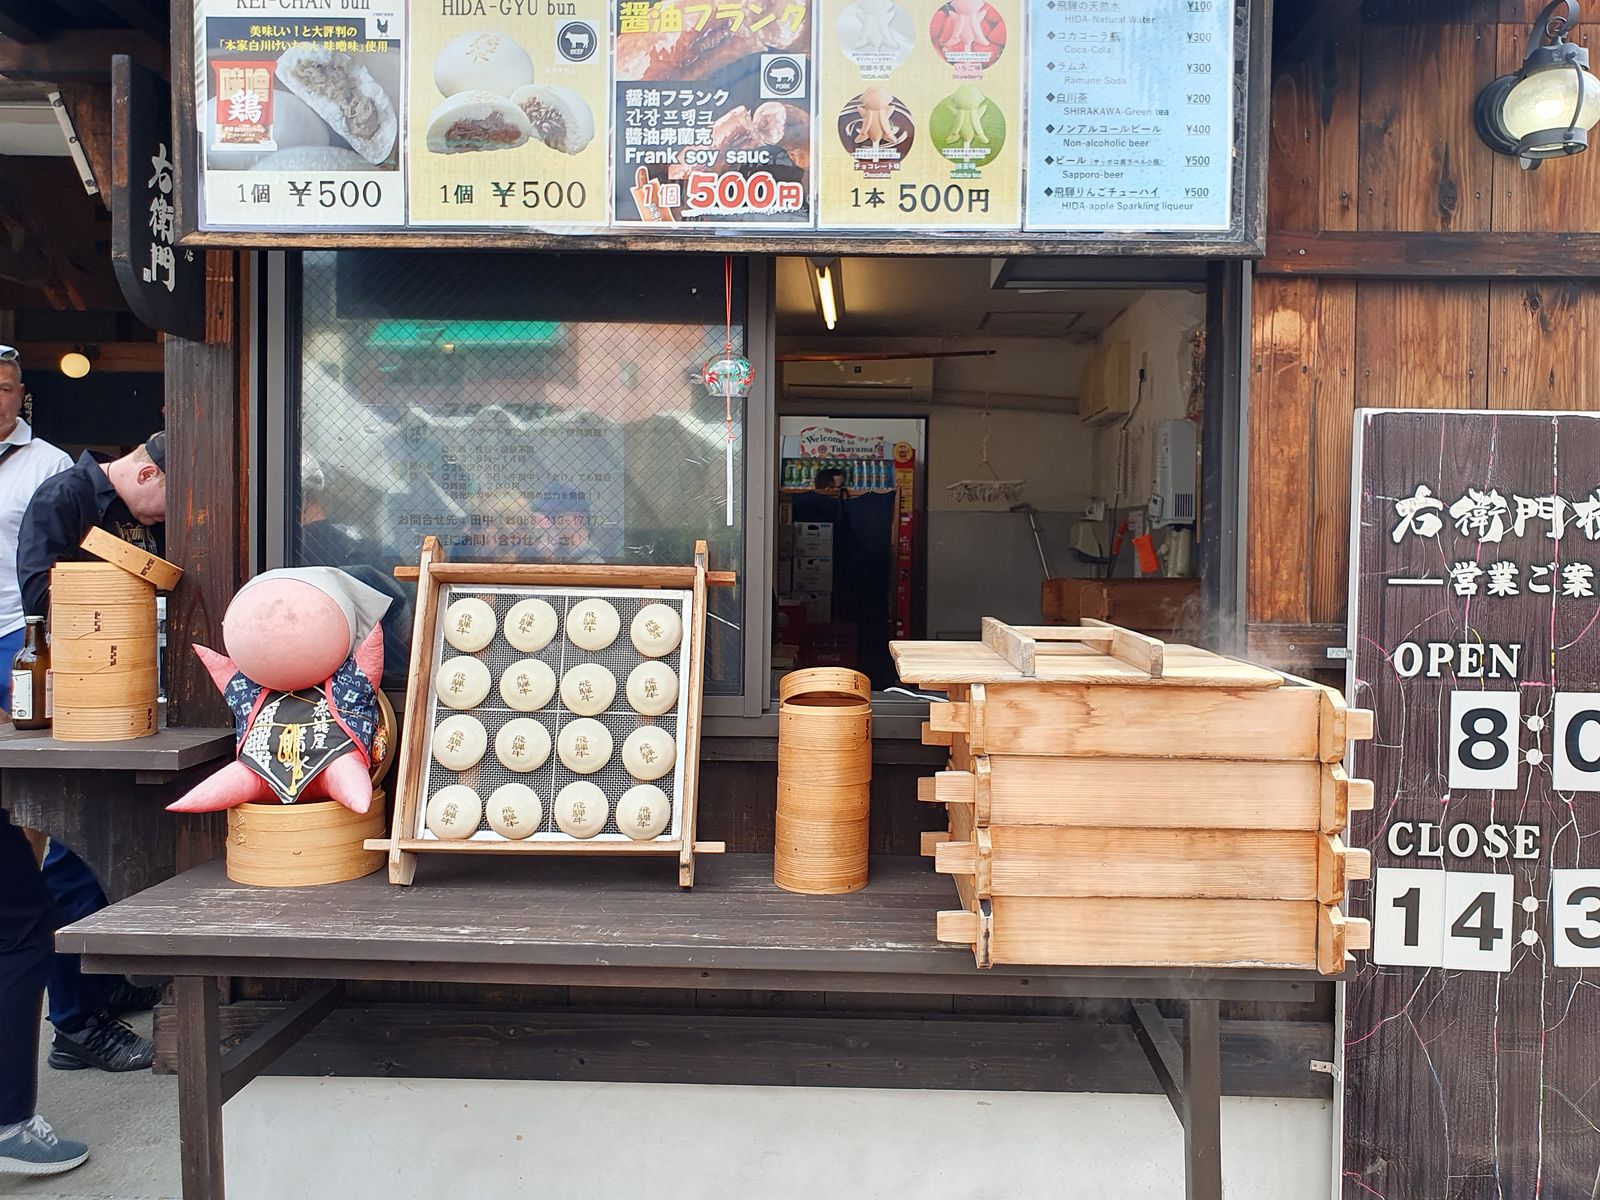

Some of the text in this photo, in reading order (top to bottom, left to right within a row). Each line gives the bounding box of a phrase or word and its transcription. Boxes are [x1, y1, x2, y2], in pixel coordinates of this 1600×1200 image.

[441, 0, 576, 16] HIDA-GYU bun
[1187, 1, 1213, 11] ¥100
[619, 1, 807, 33] 醤油フランク
[1064, 15, 1126, 24] HIDA-Natural
[250, 25, 358, 37] 美味しい！と大評判の
[1187, 32, 1212, 42] ¥300
[1064, 45, 1112, 54] Coca-Cola
[1057, 61, 1211, 73] ラムネ ¥300
[1064, 76, 1127, 85] Ramune Soda
[625, 89, 730, 107] 醤油フランク
[1056, 92, 1211, 103] 白川茶 ¥200
[227, 89, 263, 123] 鶏
[1063, 107, 1169, 116] SHIRAKAWA-Green tea
[1056, 124, 1211, 134] ノンアルコールビール ¥400
[1063, 139, 1150, 148] Non-alcoholic beer
[625, 148, 770, 166] Frank soy sauc
[1056, 156, 1087, 165] ビール
[1185, 156, 1210, 166] ¥500
[1062, 170, 1124, 180] Sapporo-beer
[237, 181, 382, 207] 1個 ¥500
[440, 181, 586, 208] 1個 ¥500
[642, 171, 804, 209] 1個 500円
[1054, 187, 1209, 197] 飛騨りんごチューハイ ¥500
[850, 184, 990, 213] 1本 500円
[1061, 201, 1194, 211] HIDA-apple Sparkling liqueur
[806, 434, 845, 444] Welcome
[831, 444, 878, 453] Takayama!
[1450, 561, 1594, 598] 営業ご案
[1393, 642, 1521, 678] OPEN
[1388, 822, 1540, 859] CLOSE
